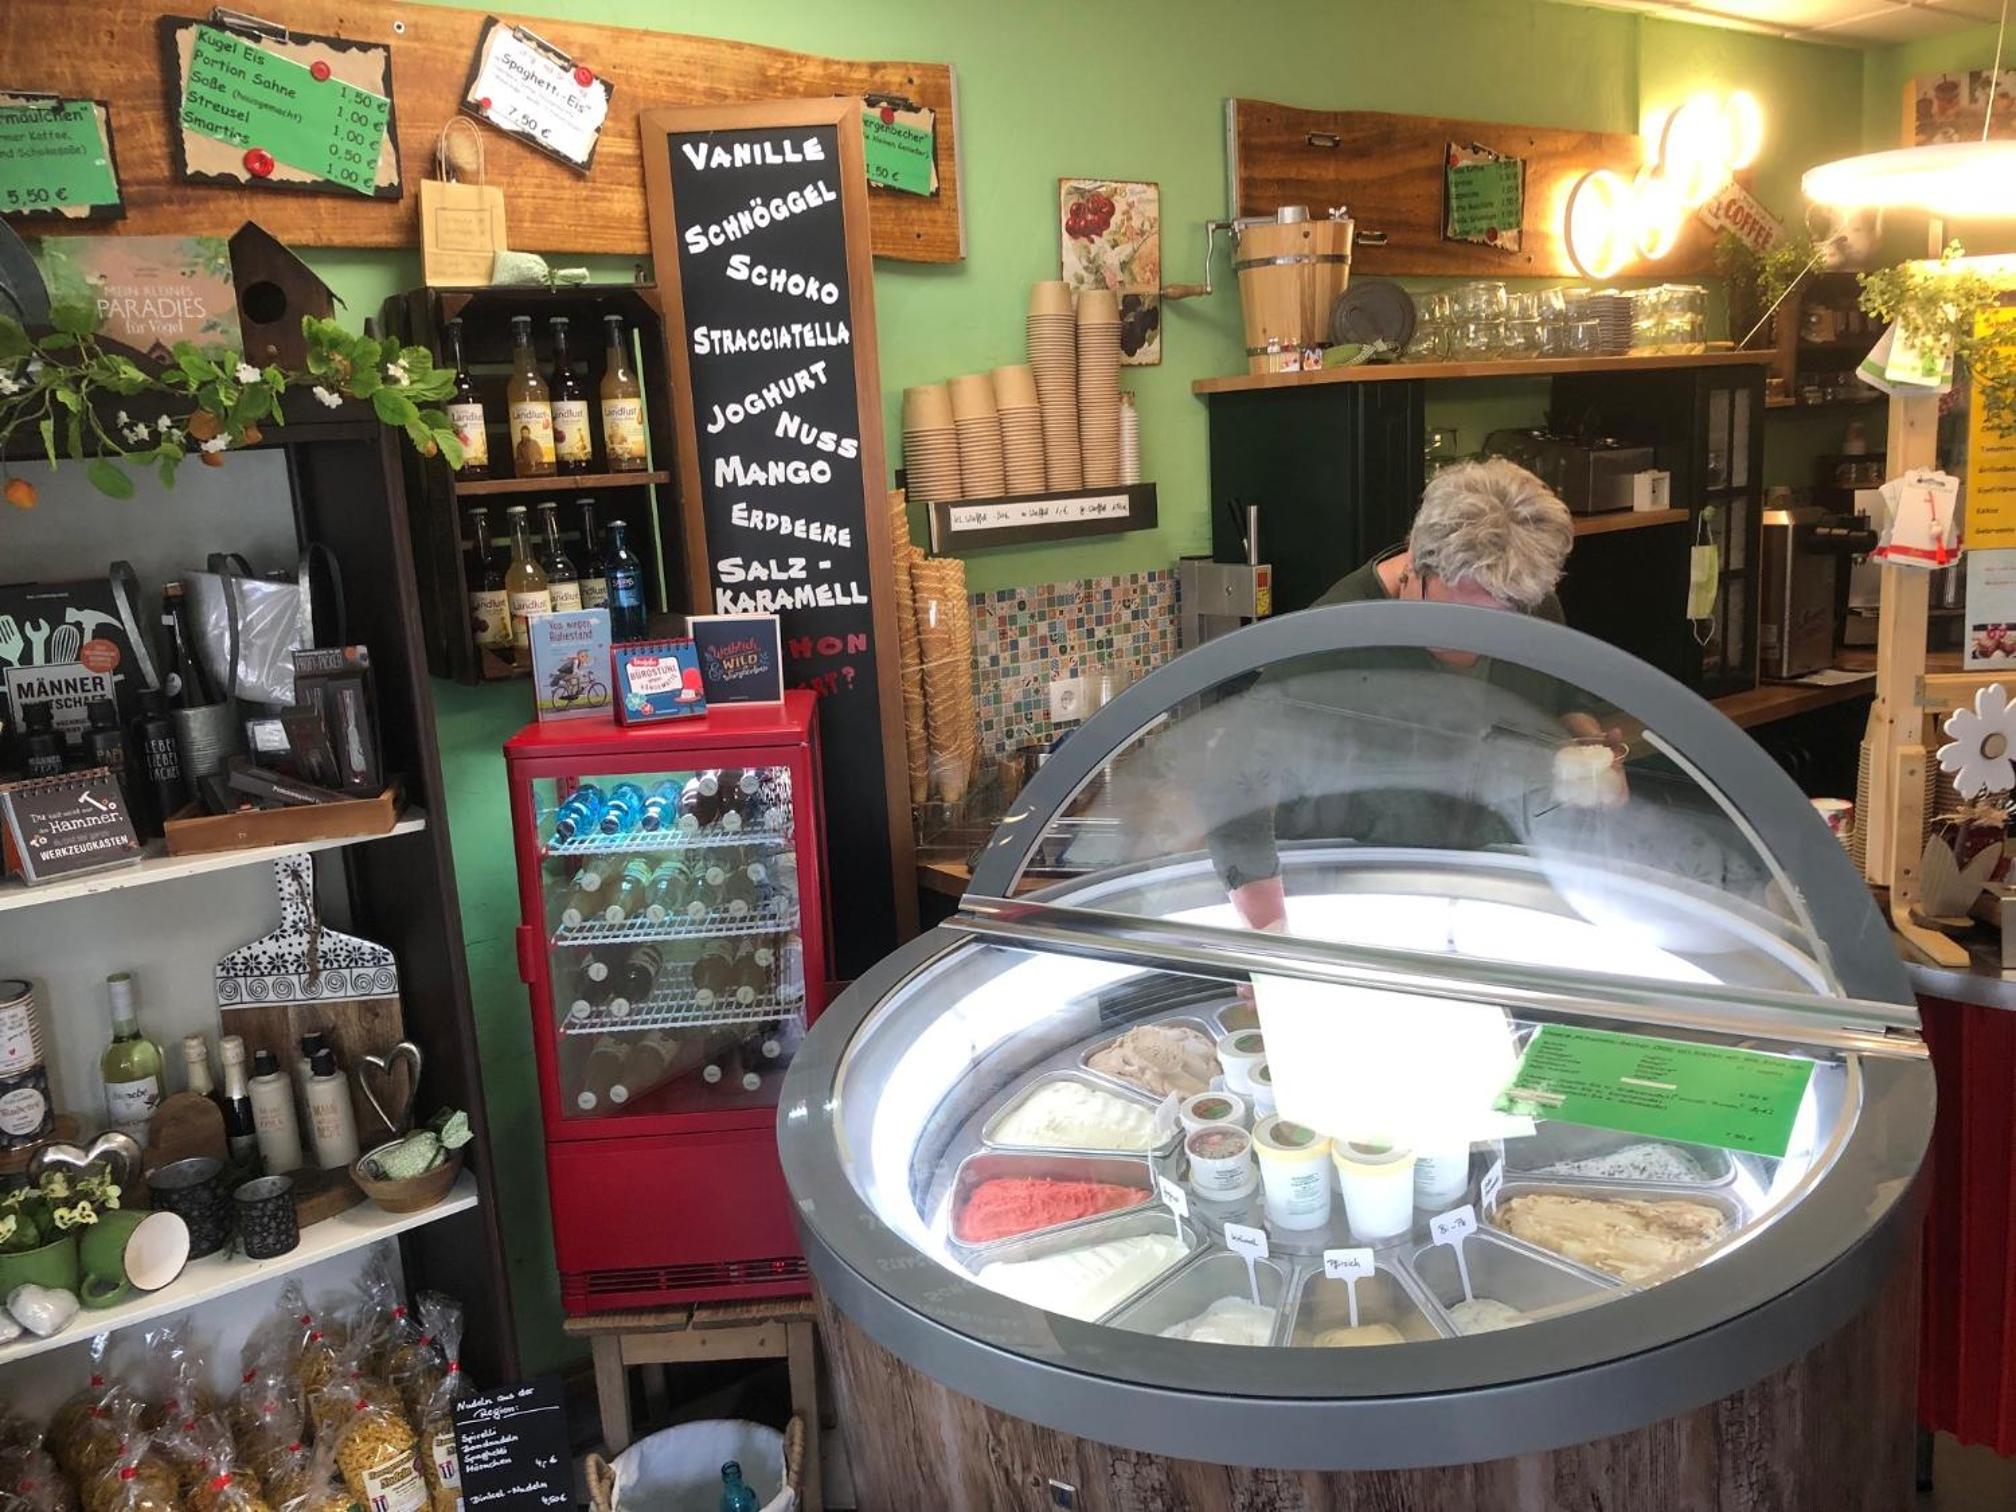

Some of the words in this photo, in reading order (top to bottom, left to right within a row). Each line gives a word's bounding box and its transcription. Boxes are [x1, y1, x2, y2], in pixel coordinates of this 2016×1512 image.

[198, 29, 238, 54] Kugel
[243, 47, 265, 66] Eis
[191, 70, 227, 94] Soße
[194, 49, 247, 80] Portion
[252, 73, 297, 100] Sahne
[186, 90, 250, 124] Streusel
[182, 111, 251, 145] Smarties
[681, 136, 826, 171] VANILLE
[55, 187, 69, 201] €
[684, 180, 837, 255] SCHNÖGGEL
[725, 253, 839, 305] SCHOKO
[98, 298, 206, 319] PARADIES
[693, 321, 850, 356] STRACCIATELLA
[706, 360, 828, 434] JOGHURT
[774, 410, 859, 459] NUSS
[714, 454, 832, 488] MANGO
[731, 502, 852, 549] ERDBEERE
[715, 581, 869, 615] KARAMELL
[722, 654, 758, 670] WILD
[16, 676, 105, 699] MÄNNER
[48, 812, 123, 834] Hammer,
[40, 834, 128, 861] WERKZEUGKASTEN
[457, 1397, 493, 1411] Nudeln
